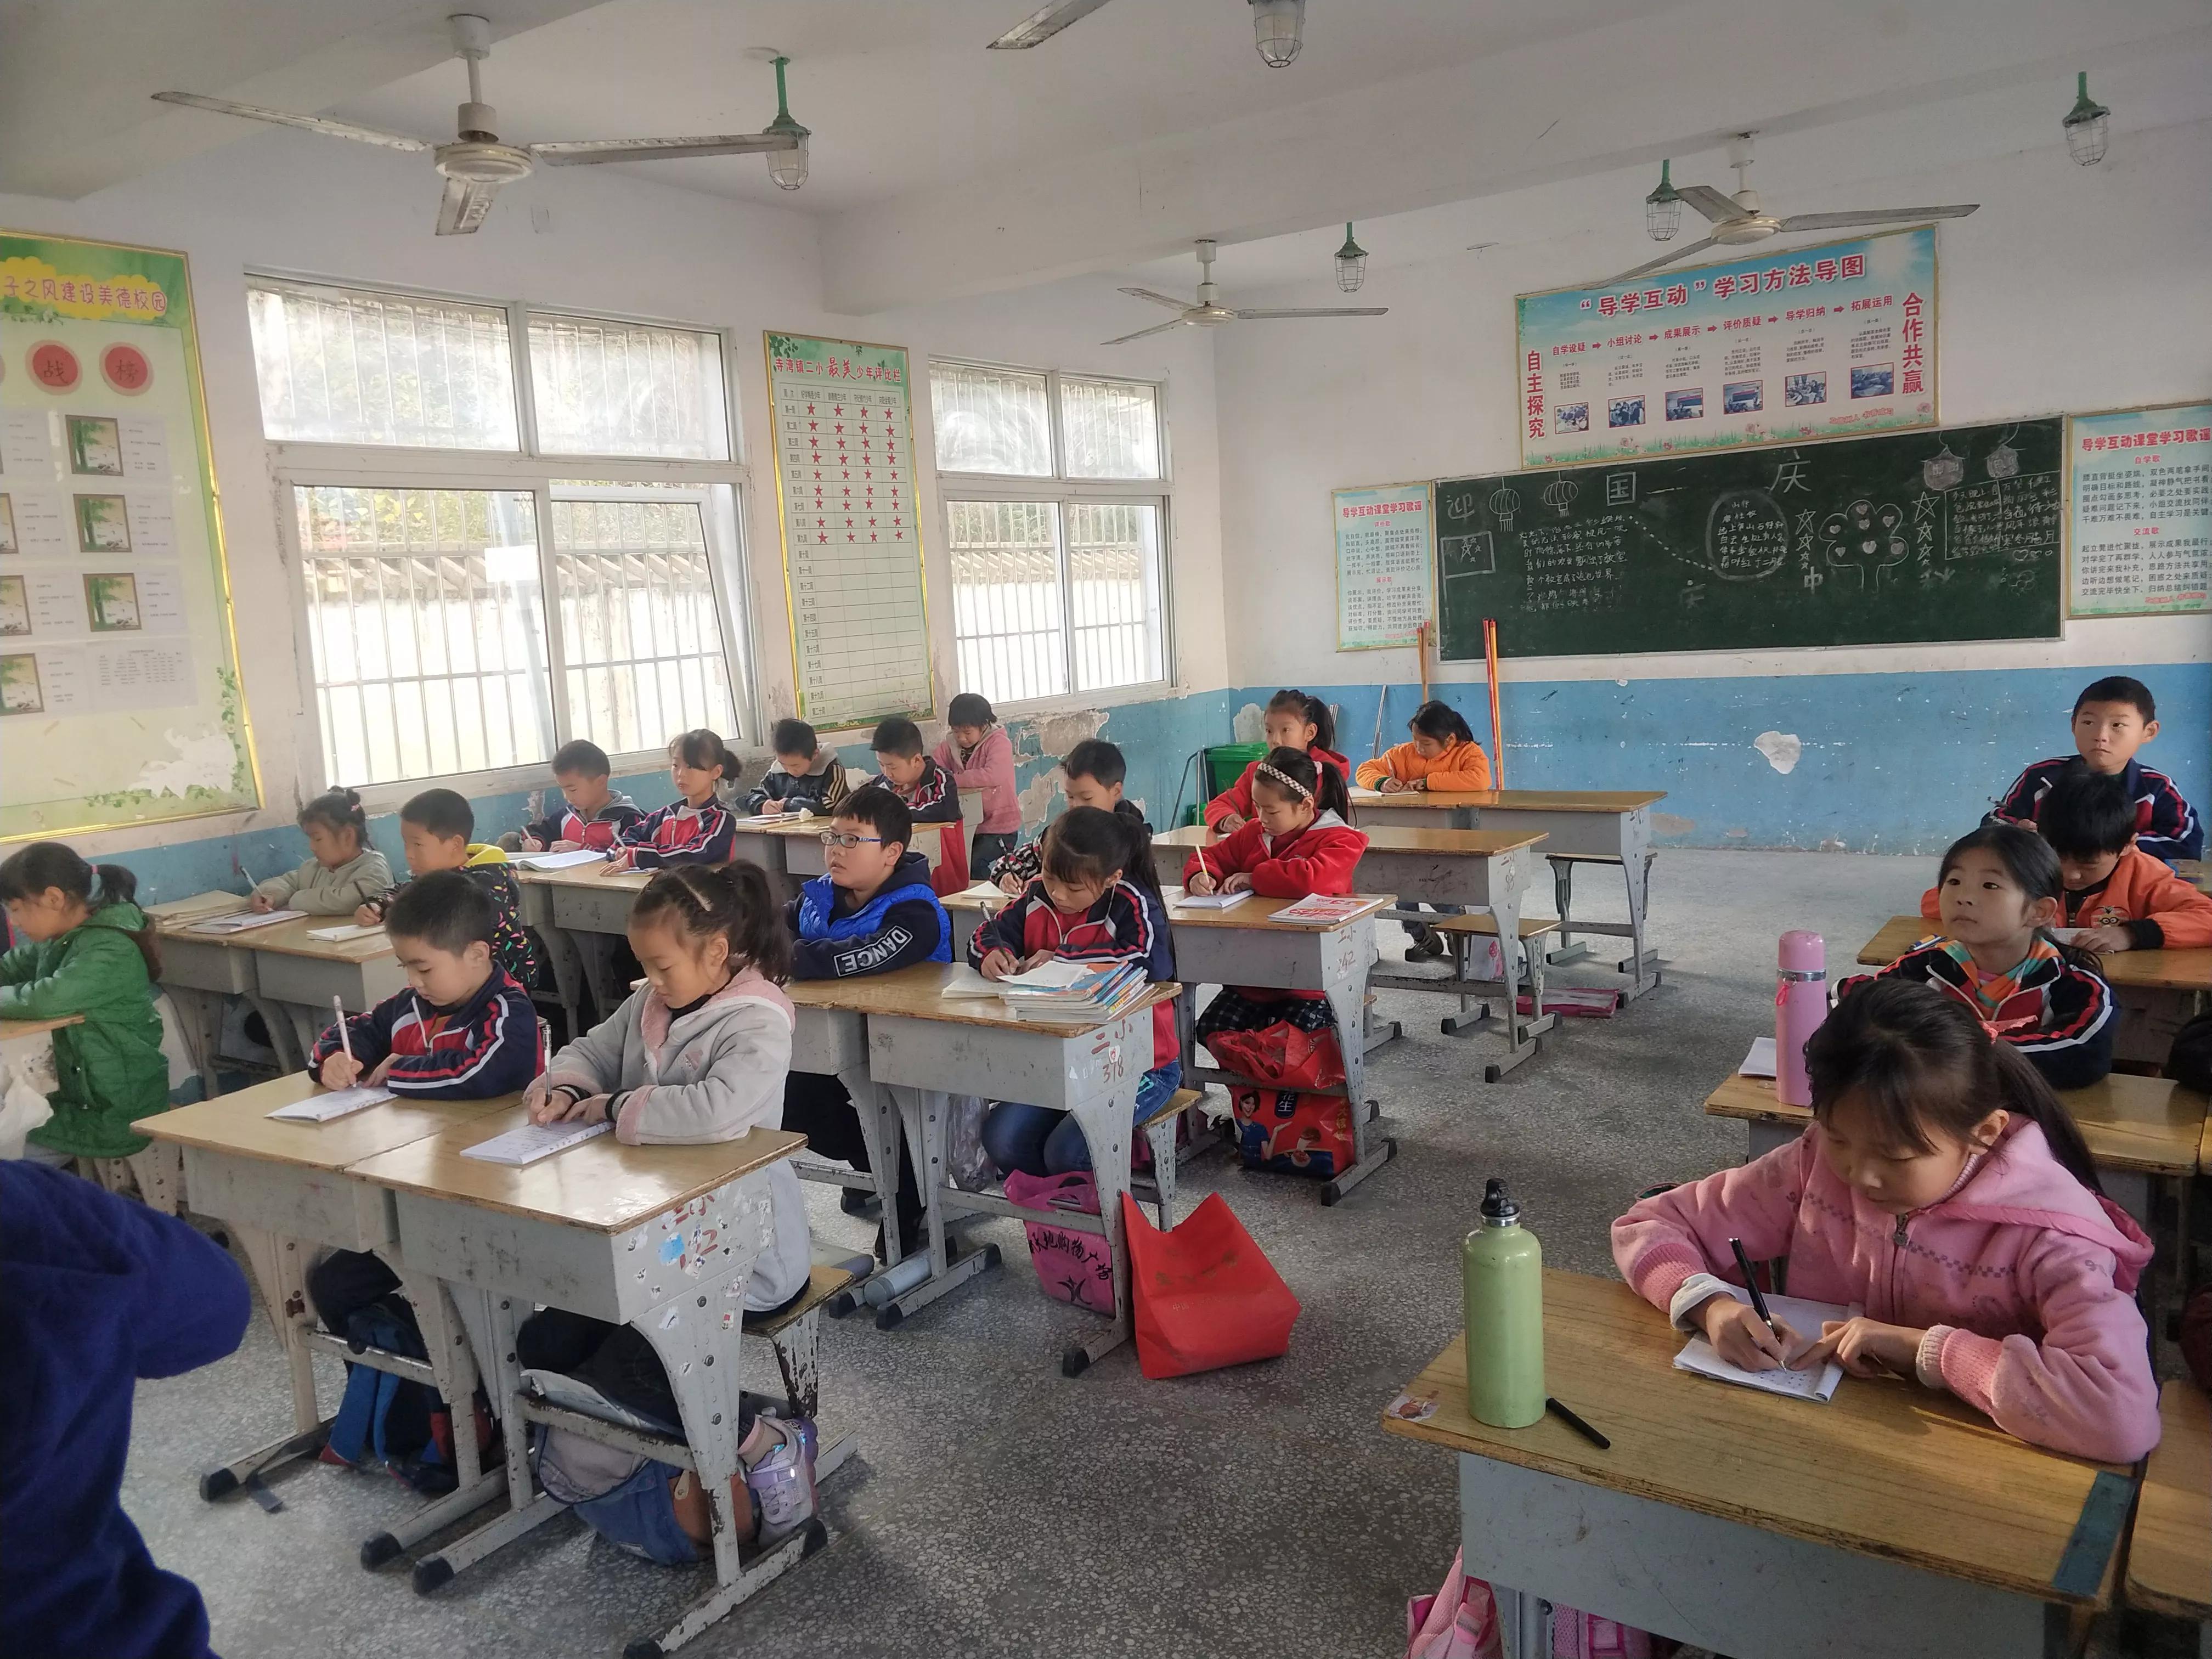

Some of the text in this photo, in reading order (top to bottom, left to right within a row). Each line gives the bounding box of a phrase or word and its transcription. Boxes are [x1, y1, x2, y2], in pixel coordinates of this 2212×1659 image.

[4, 276, 166, 312] 子之风建设美德校园
[1553, 295, 1892, 356] 自学设疑 小组讨论 成果展示 评价质疑 导学归纳 拓展运用
[1902, 292, 1925, 394] 合作共赢
[1527, 351, 1546, 439] 自主探究
[2083, 428, 2211, 452] 导学互动课堂学习歌谣
[2135, 455, 2160, 464] 自学歌
[1447, 449, 1811, 520] 迎 国 庆
[1342, 500, 1422, 518] 导学互动课堂学习歌谣
[2134, 527, 2159, 535] 交流歌
[1804, 566, 1824, 594] 中
[841, 929, 907, 972] DANCE
[1091, 1019, 1133, 1054] 二小
